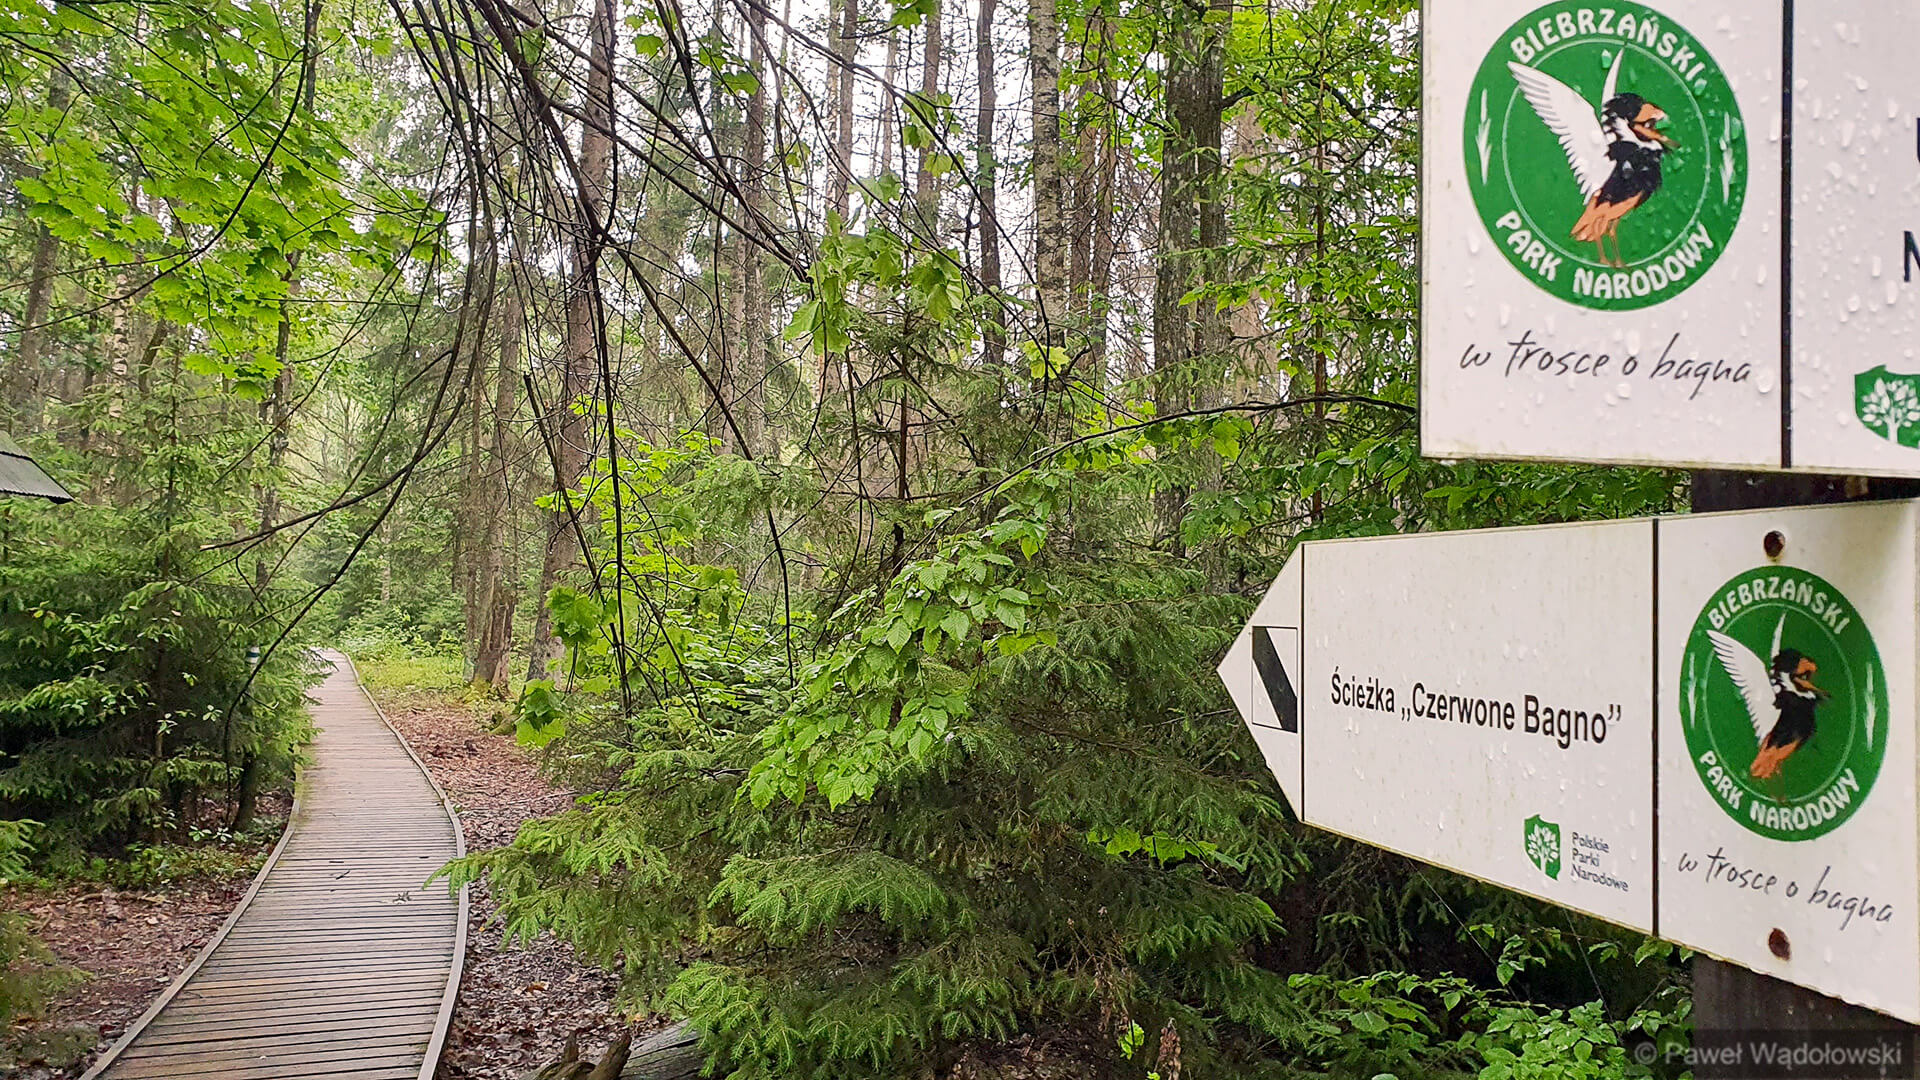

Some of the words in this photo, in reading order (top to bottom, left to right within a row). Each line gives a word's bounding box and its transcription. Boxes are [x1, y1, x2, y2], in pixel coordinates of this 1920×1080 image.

[1510, 8, 1706, 81] BIEBRZAŃSKI
[1496, 210, 1564, 282] PARK
[1573, 223, 1715, 300] NARODOWY
[1460, 344, 1490, 371] w
[1506, 330, 1611, 378] trosce
[1622, 356, 1637, 376] o
[1650, 333, 1751, 400] bagna
[1707, 576, 1850, 635] BIEBRZAŃSKI
[1331, 666, 1395, 713] Ścieżka
[1700, 751, 1744, 810] PARK
[1750, 768, 1861, 832] NARODOWY
[1572, 832, 1610, 854] Polskie
[1572, 848, 1600, 867] Parki
[1570, 864, 1629, 892] Narodowe
[1678, 852, 1699, 872] w
[1705, 847, 1778, 895] trosce
[1786, 881, 1799, 898] o
[1808, 865, 1894, 931] bagna
